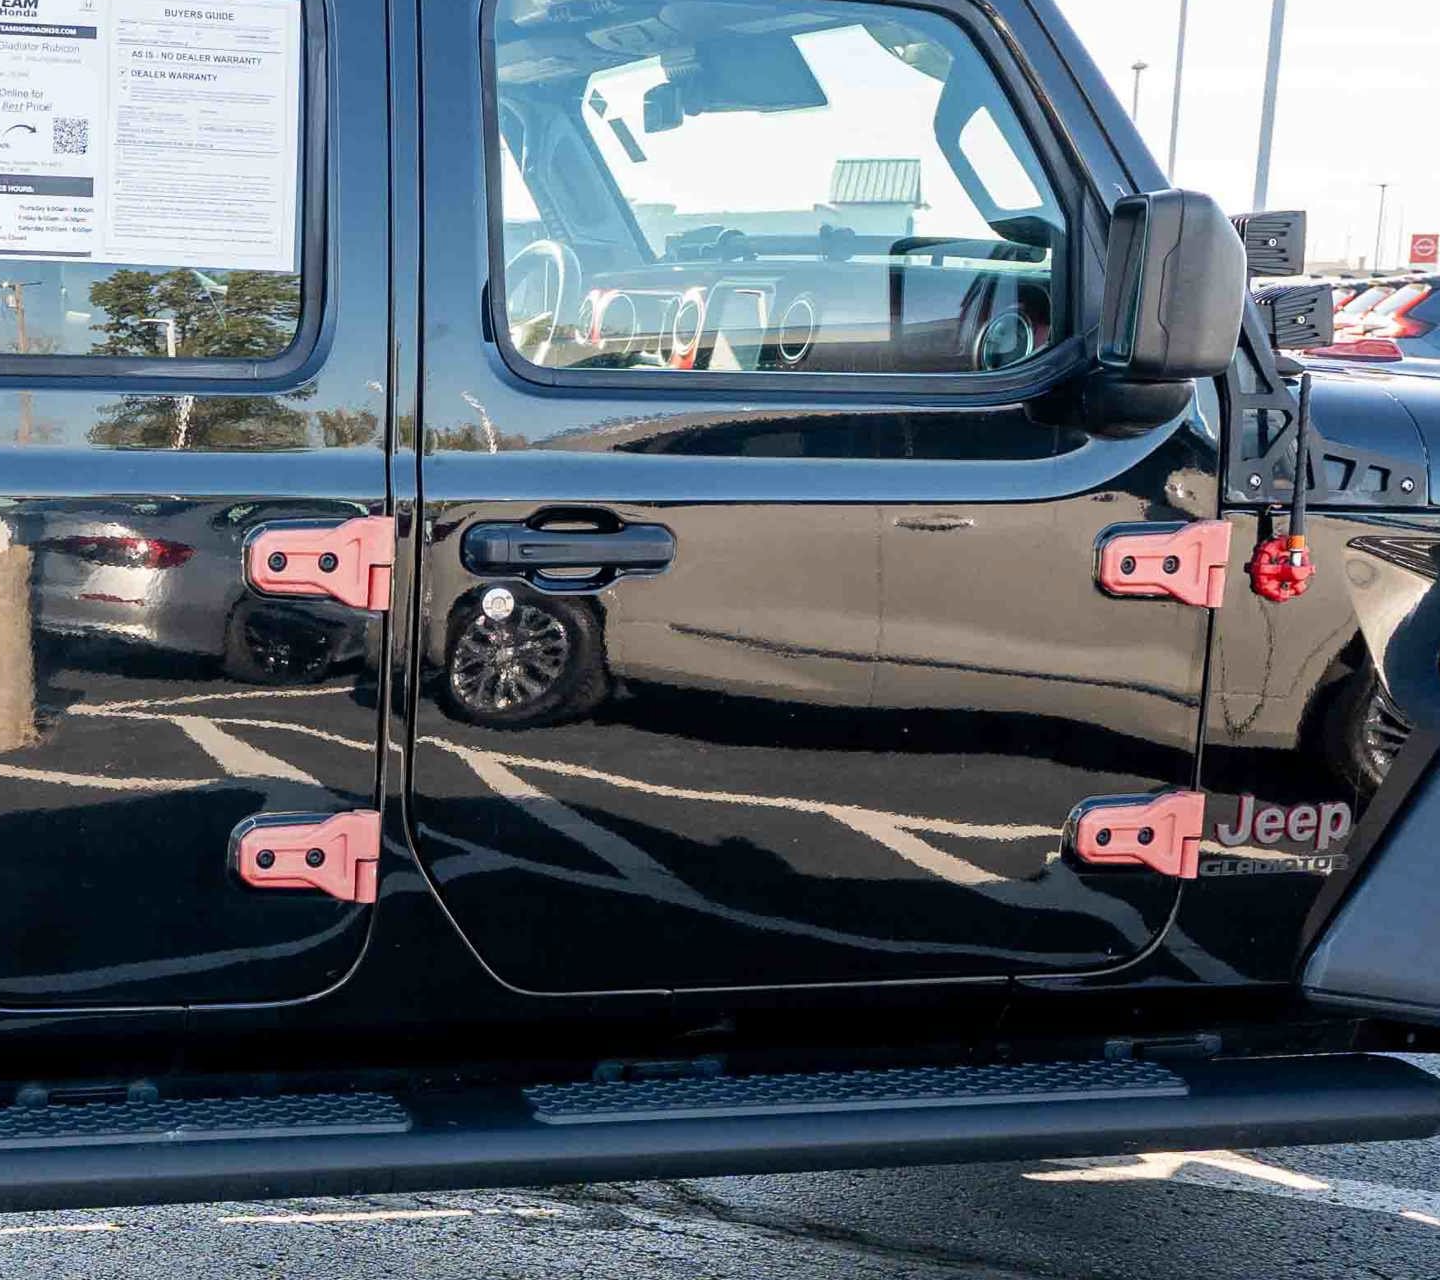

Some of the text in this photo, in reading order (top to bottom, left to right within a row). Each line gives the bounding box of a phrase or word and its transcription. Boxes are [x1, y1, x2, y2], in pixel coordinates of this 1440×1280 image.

[0, 8, 37, 17] Honda
[165, 8, 235, 21] BUYERS GUIDE
[42, 42, 80, 54] Rubicon
[131, 50, 143, 58] AS
[145, 51, 154, 59] IS
[161, 51, 174, 60] NO
[176, 53, 211, 63] DEALER
[213, 55, 263, 65] WARRANTY
[131, 69, 218, 81] DEALER WARRANTY
[31, 88, 44, 99] for
[1216, 792, 1352, 850] Jeep
[1199, 853, 1350, 876] GLADIATOR
